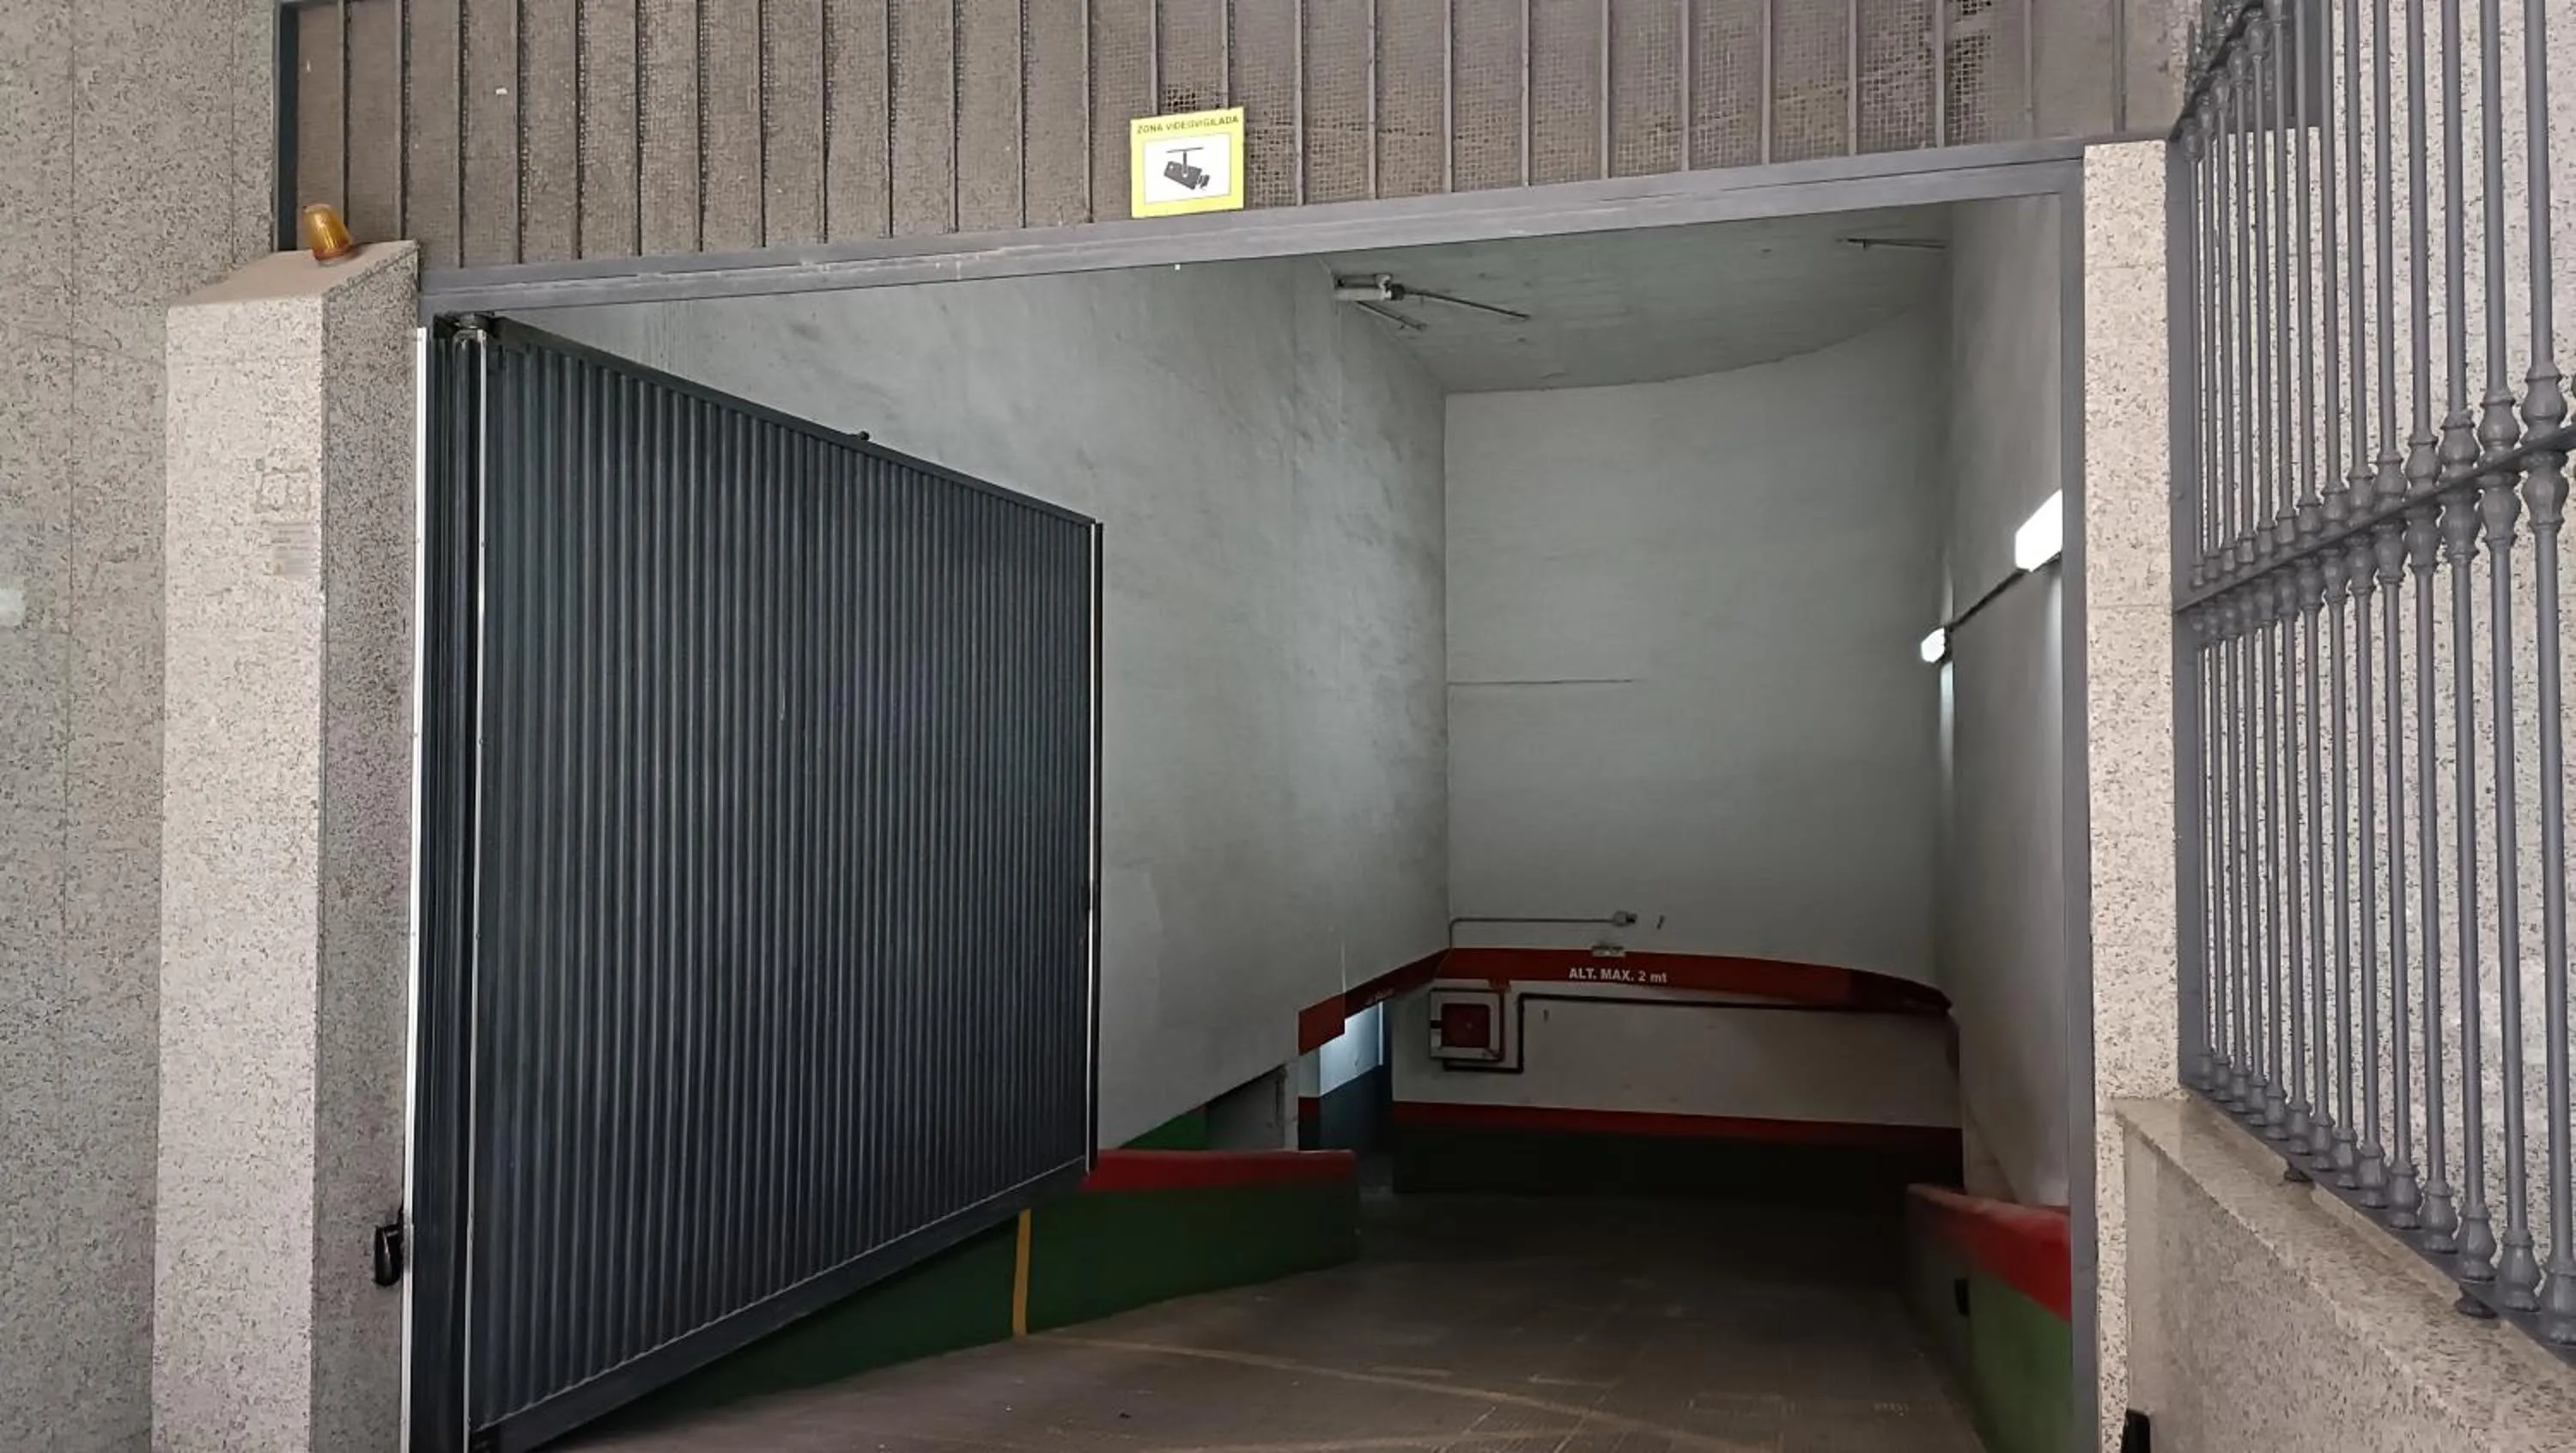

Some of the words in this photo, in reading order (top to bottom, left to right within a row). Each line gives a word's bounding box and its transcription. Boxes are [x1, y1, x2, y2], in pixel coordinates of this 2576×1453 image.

[1137, 124, 1163, 134] ZONA
[1166, 115, 1239, 130] VIDEOVIGILADA
[1569, 967, 1597, 979] ALT.
[1601, 968, 1634, 982] MAX.
[1638, 970, 1646, 982] 2
[1650, 971, 1668, 983] mt
